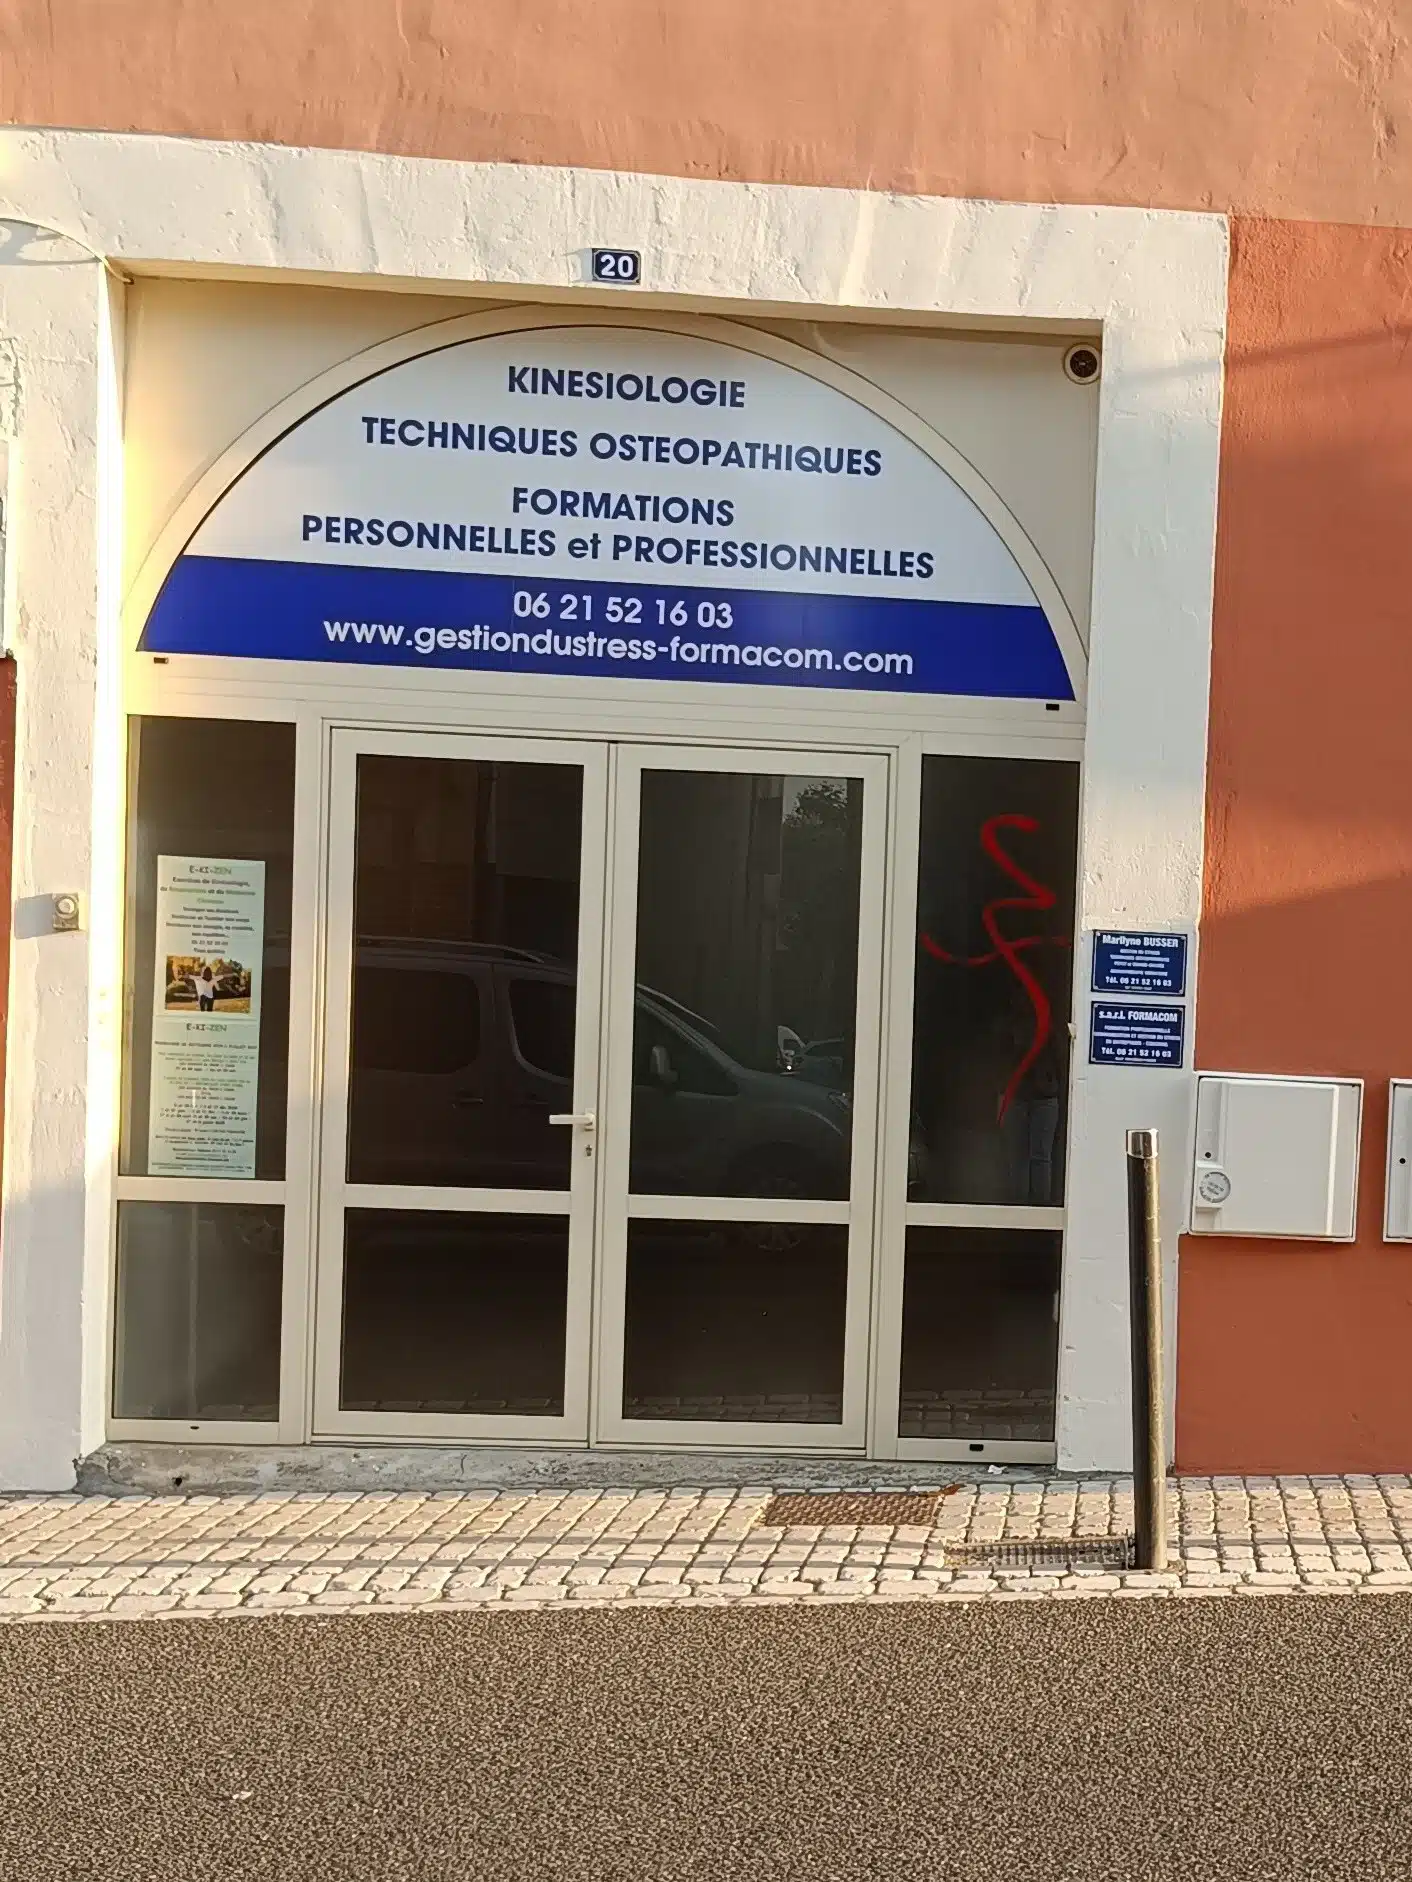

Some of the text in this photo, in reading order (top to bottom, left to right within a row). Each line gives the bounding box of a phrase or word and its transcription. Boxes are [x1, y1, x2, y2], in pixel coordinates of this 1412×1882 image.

[600, 253, 634, 278] 20
[508, 365, 746, 408] KINESIOLOGIE
[361, 416, 882, 477] TECHNIQUES OSTEOPATHIQUES
[512, 486, 735, 527] FORMATIONS
[302, 514, 934, 579] PERSONNELLES et PROFESSIONNELLES
[513, 590, 734, 629] 06 21 52 16 03
[323, 620, 913, 675] www.gestiondustress-formacom.com
[1143, 936, 1179, 948] BUSSER
[1127, 1011, 1178, 1023] FORMACOM
[1127, 1048, 1137, 1056] 21
